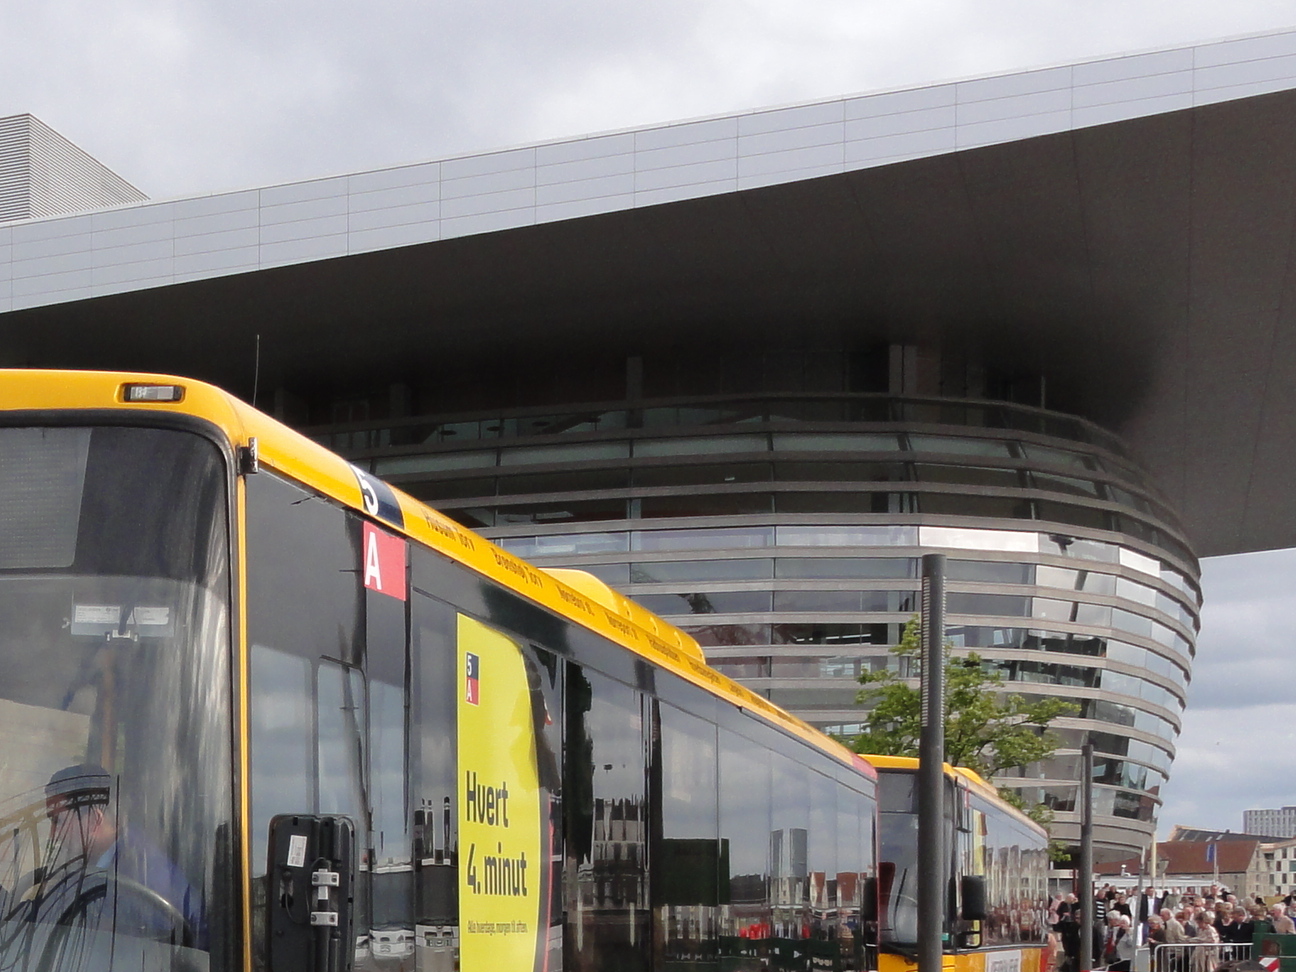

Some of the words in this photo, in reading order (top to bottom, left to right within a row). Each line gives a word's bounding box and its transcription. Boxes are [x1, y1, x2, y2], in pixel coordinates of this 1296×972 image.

[351, 464, 379, 516] 5
[365, 532, 382, 590] A
[466, 654, 473, 676] 5
[466, 684, 473, 702] A
[467, 770, 509, 829] Hvert
[467, 843, 481, 895] 4.
[484, 842, 528, 897] minut
